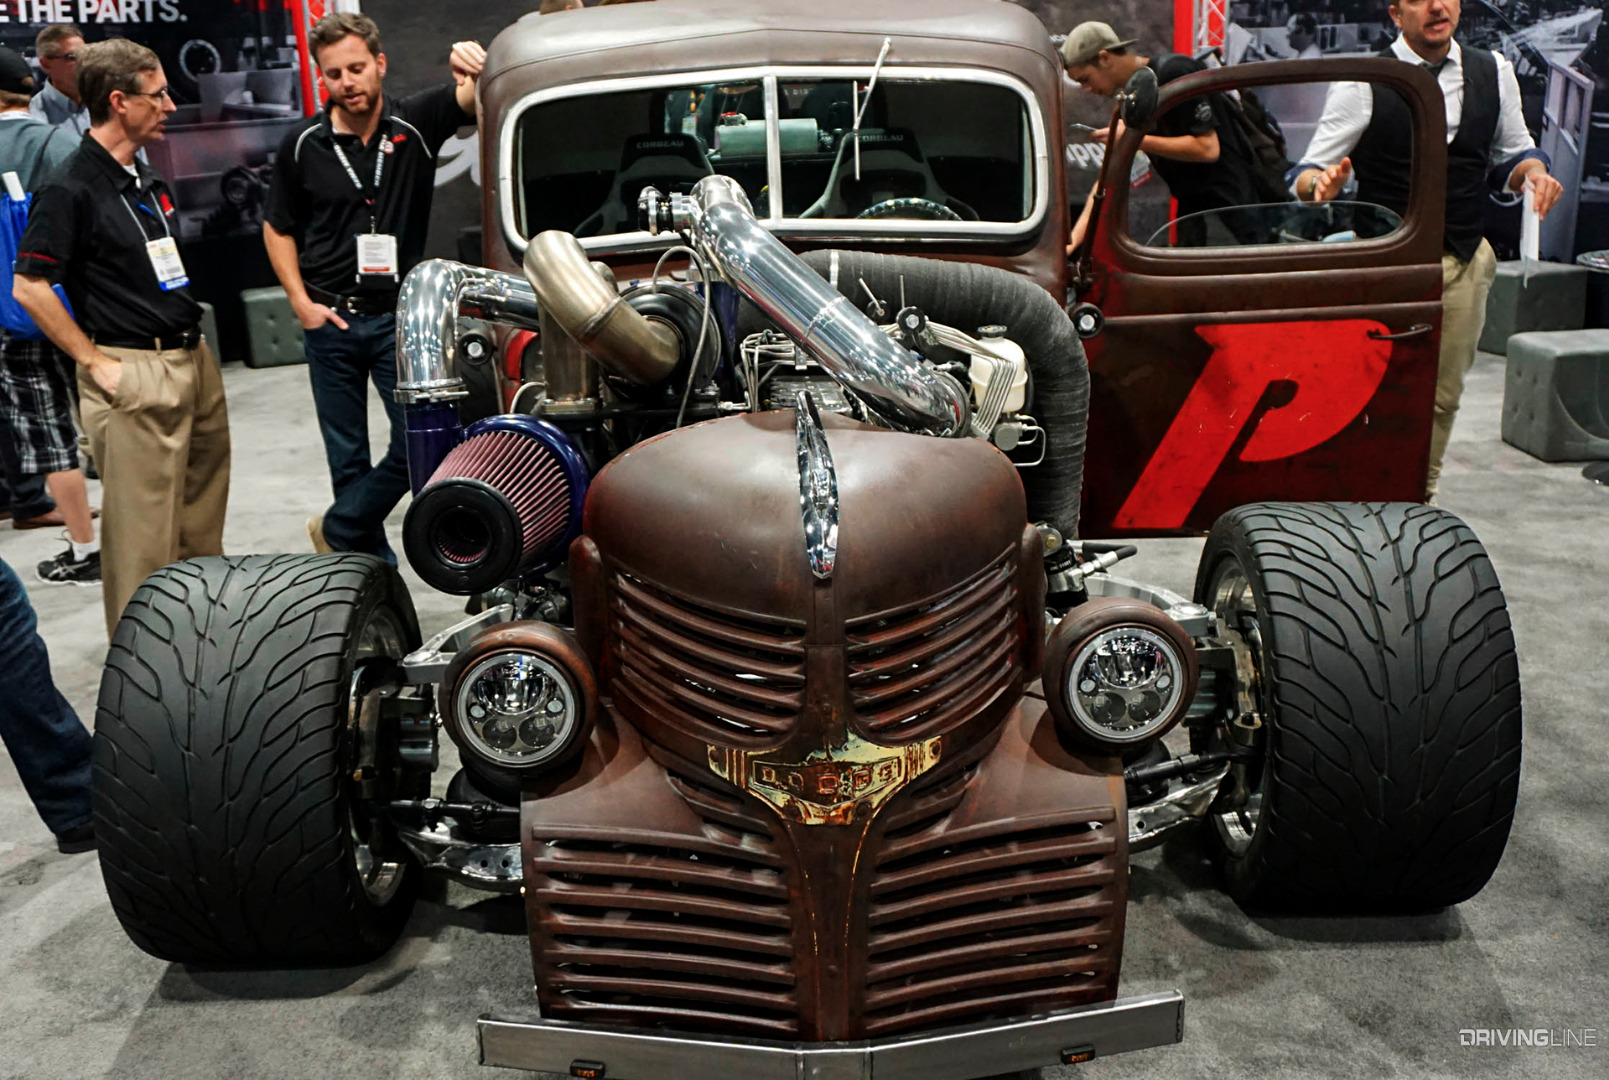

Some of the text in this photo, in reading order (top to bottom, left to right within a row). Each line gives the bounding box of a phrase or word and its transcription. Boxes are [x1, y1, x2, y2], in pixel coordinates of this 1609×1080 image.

[17, 0, 74, 23] THE
[78, 0, 188, 22] PARTS.
[762, 765, 894, 795] DODGE
